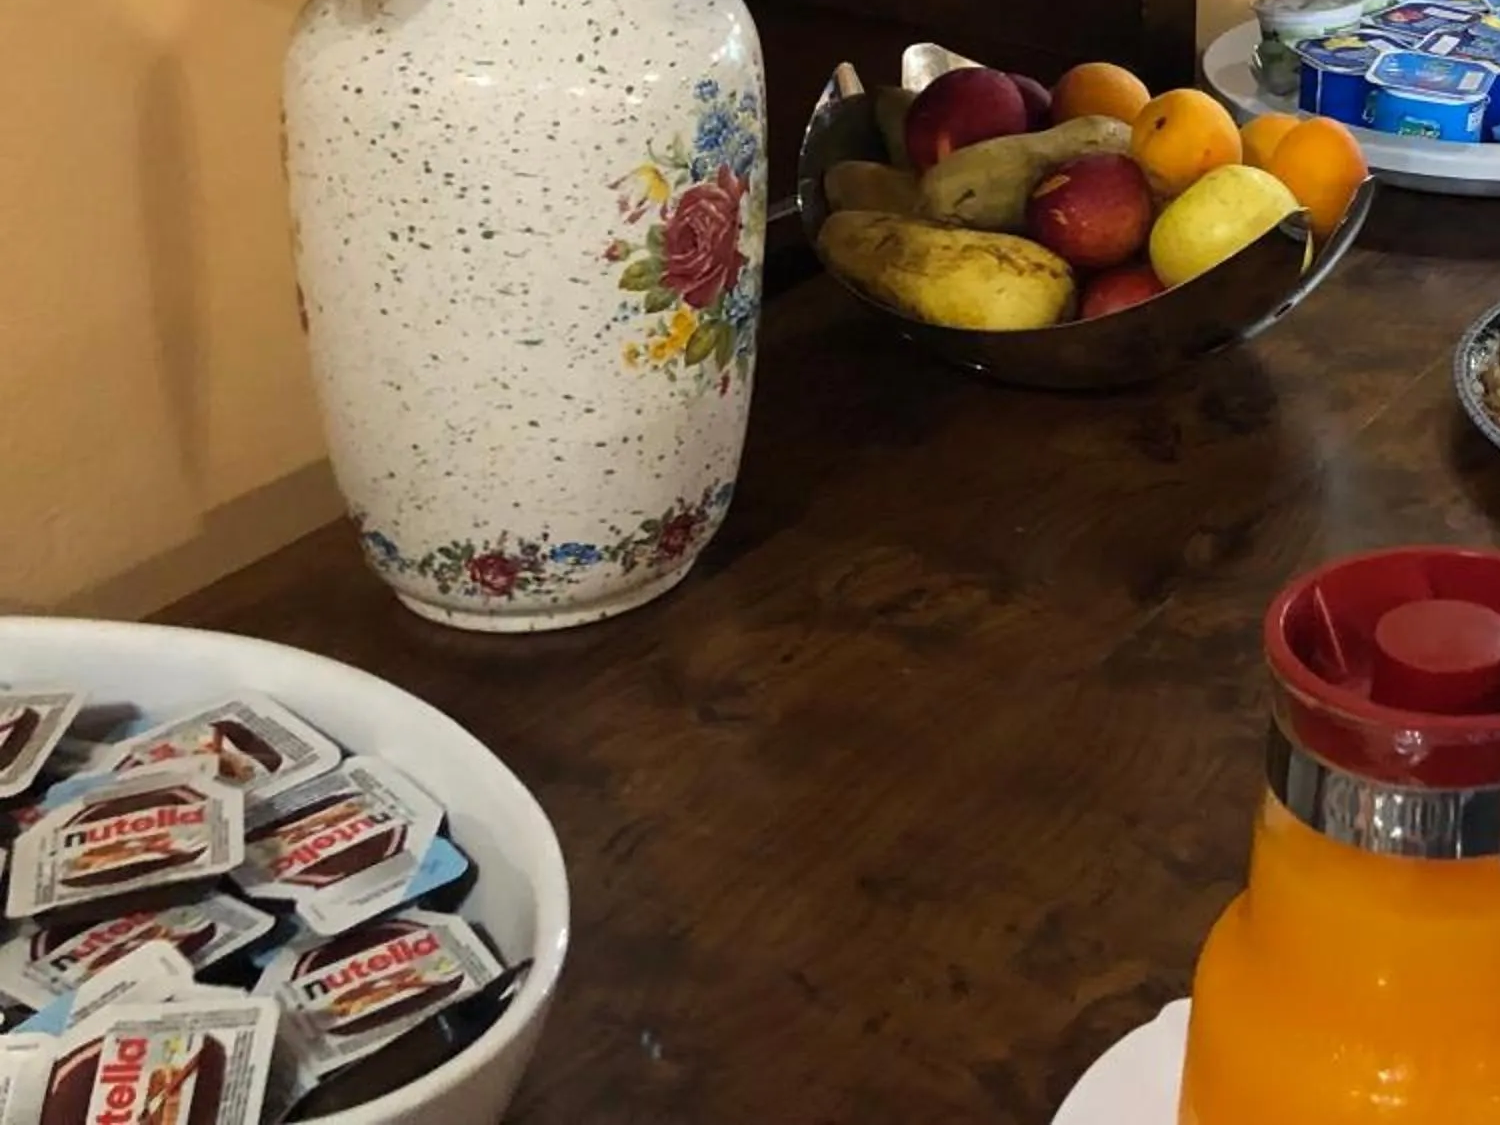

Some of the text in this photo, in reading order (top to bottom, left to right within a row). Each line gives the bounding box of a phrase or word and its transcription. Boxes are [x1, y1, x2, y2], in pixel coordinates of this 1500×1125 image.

[64, 806, 206, 848] nutella
[303, 932, 440, 1000] nutella
[96, 1038, 150, 1125] tella
